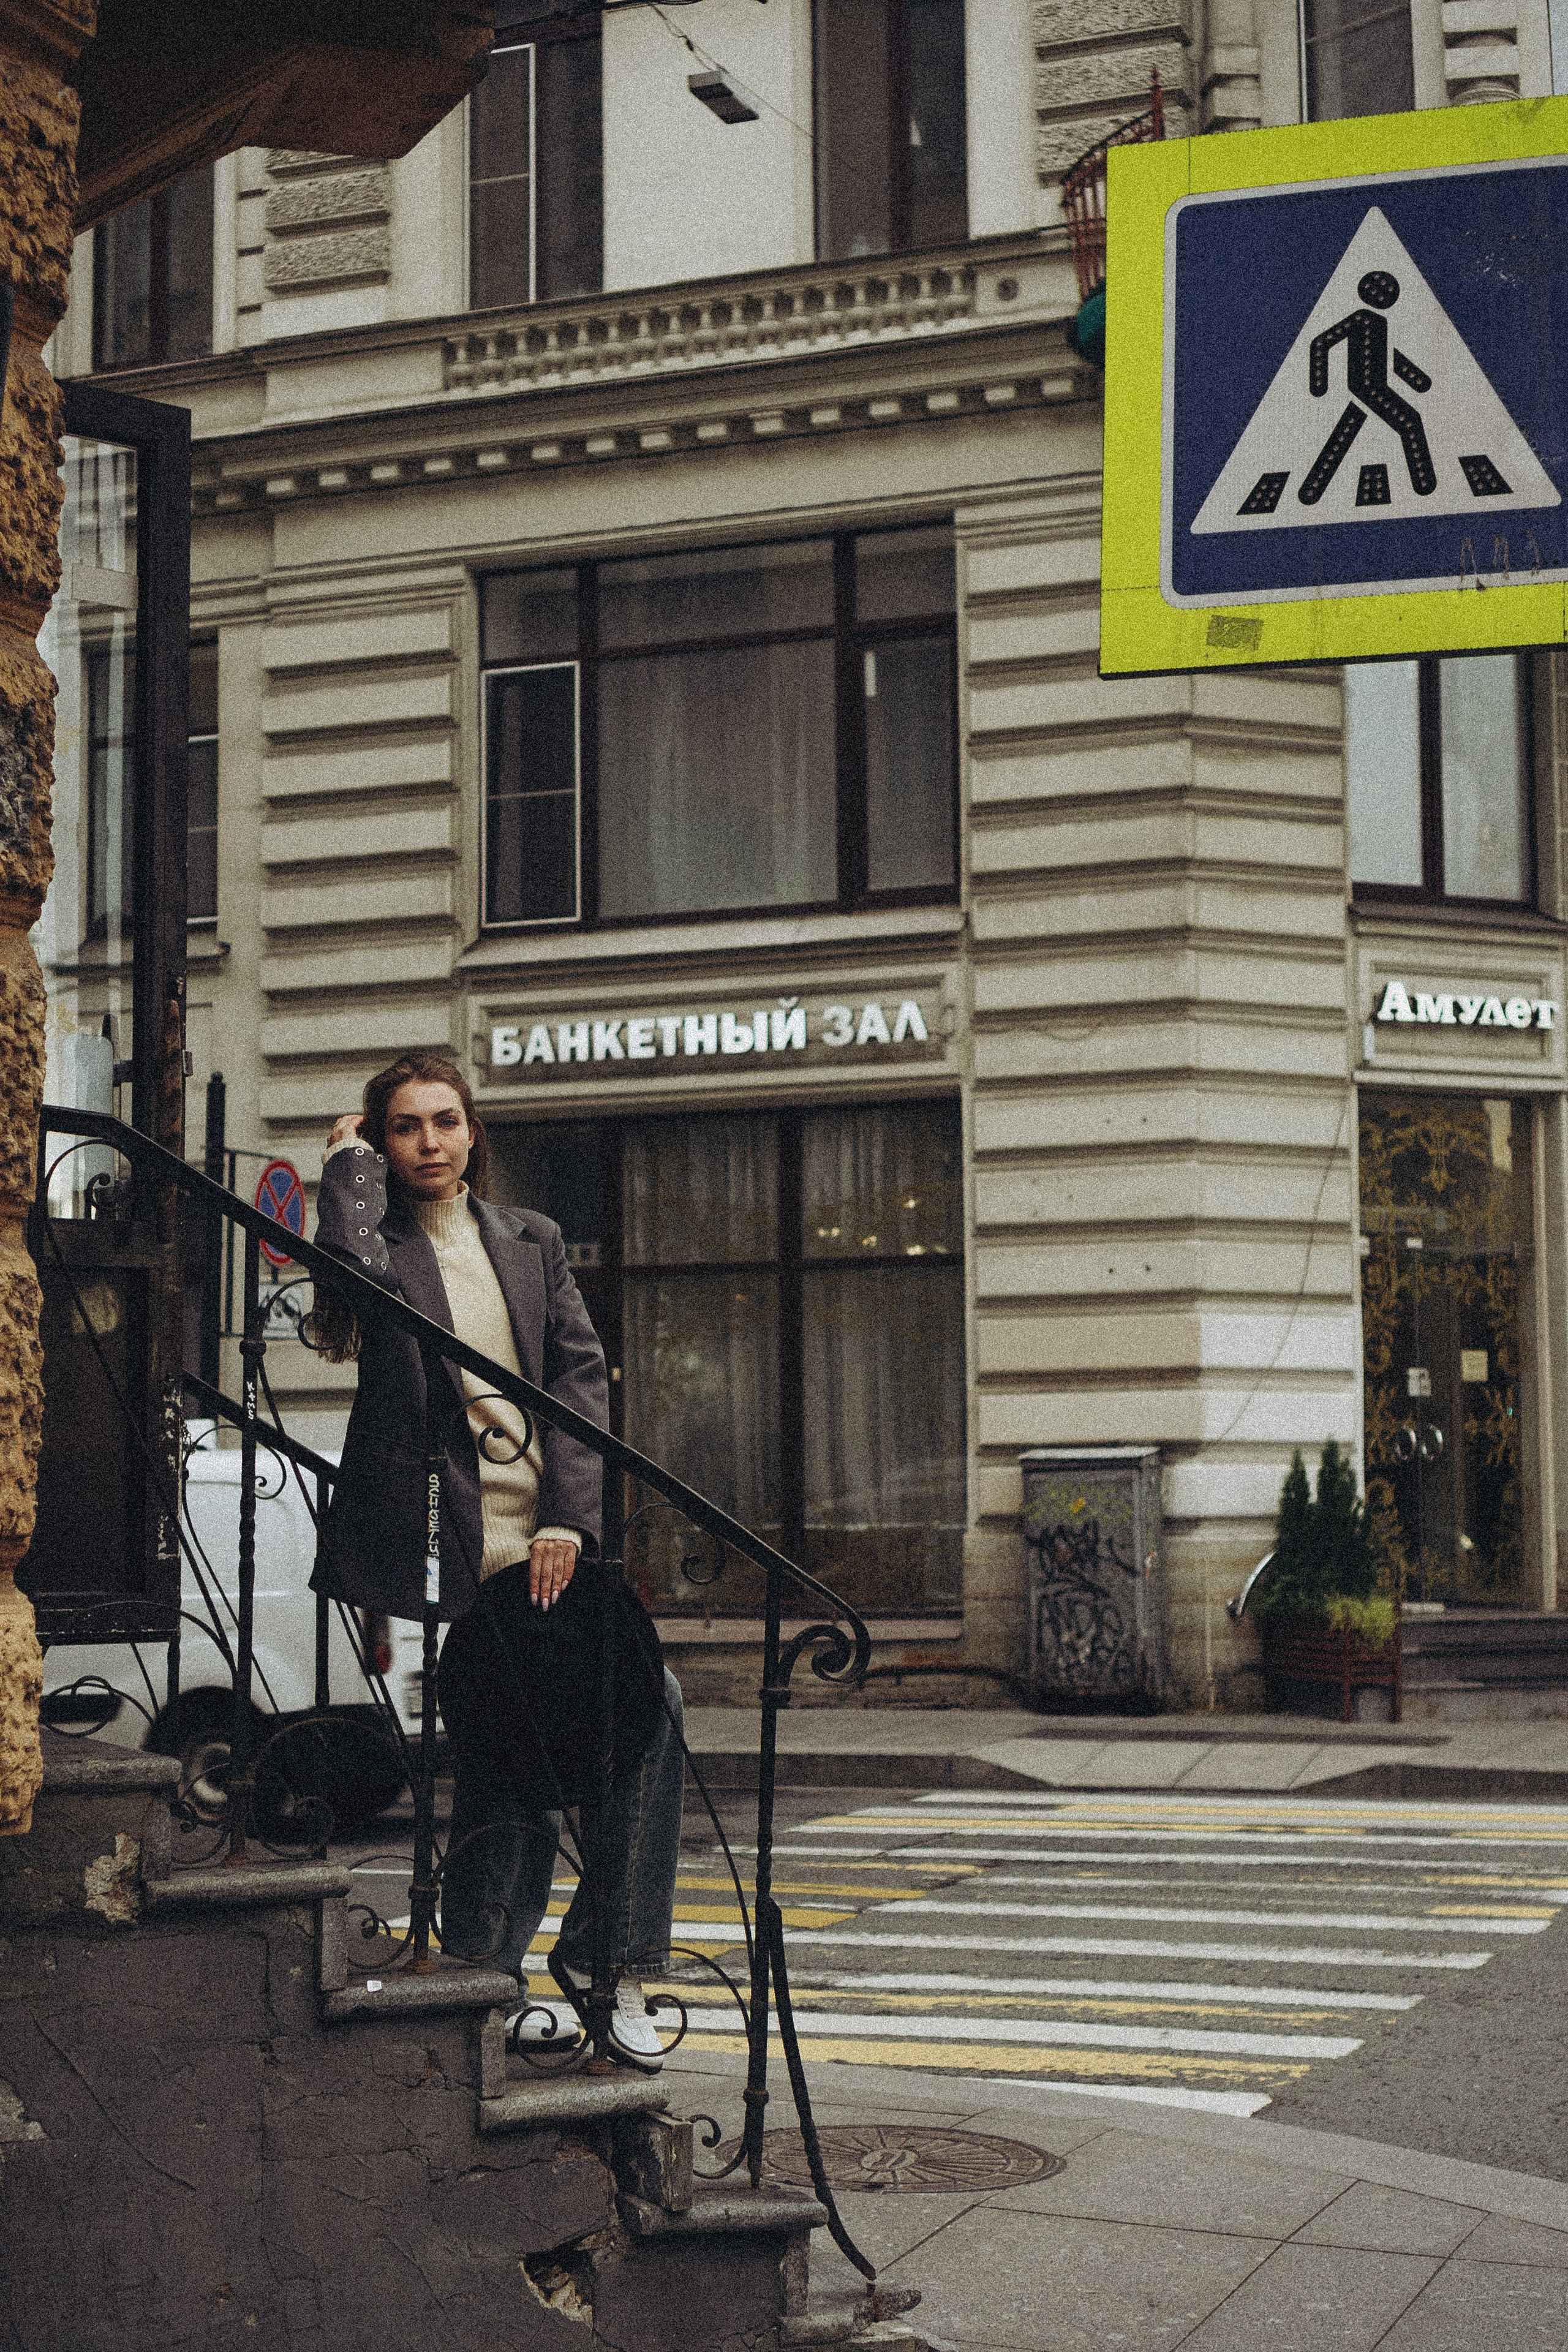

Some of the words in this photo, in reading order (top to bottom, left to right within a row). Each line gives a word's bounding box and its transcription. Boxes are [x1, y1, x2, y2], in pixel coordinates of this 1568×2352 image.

[492, 998, 806, 1065] БАНКЕТНЫЙ
[820, 999, 929, 1046] ЗАЛ
[1378, 980, 1559, 1029] Амулет
